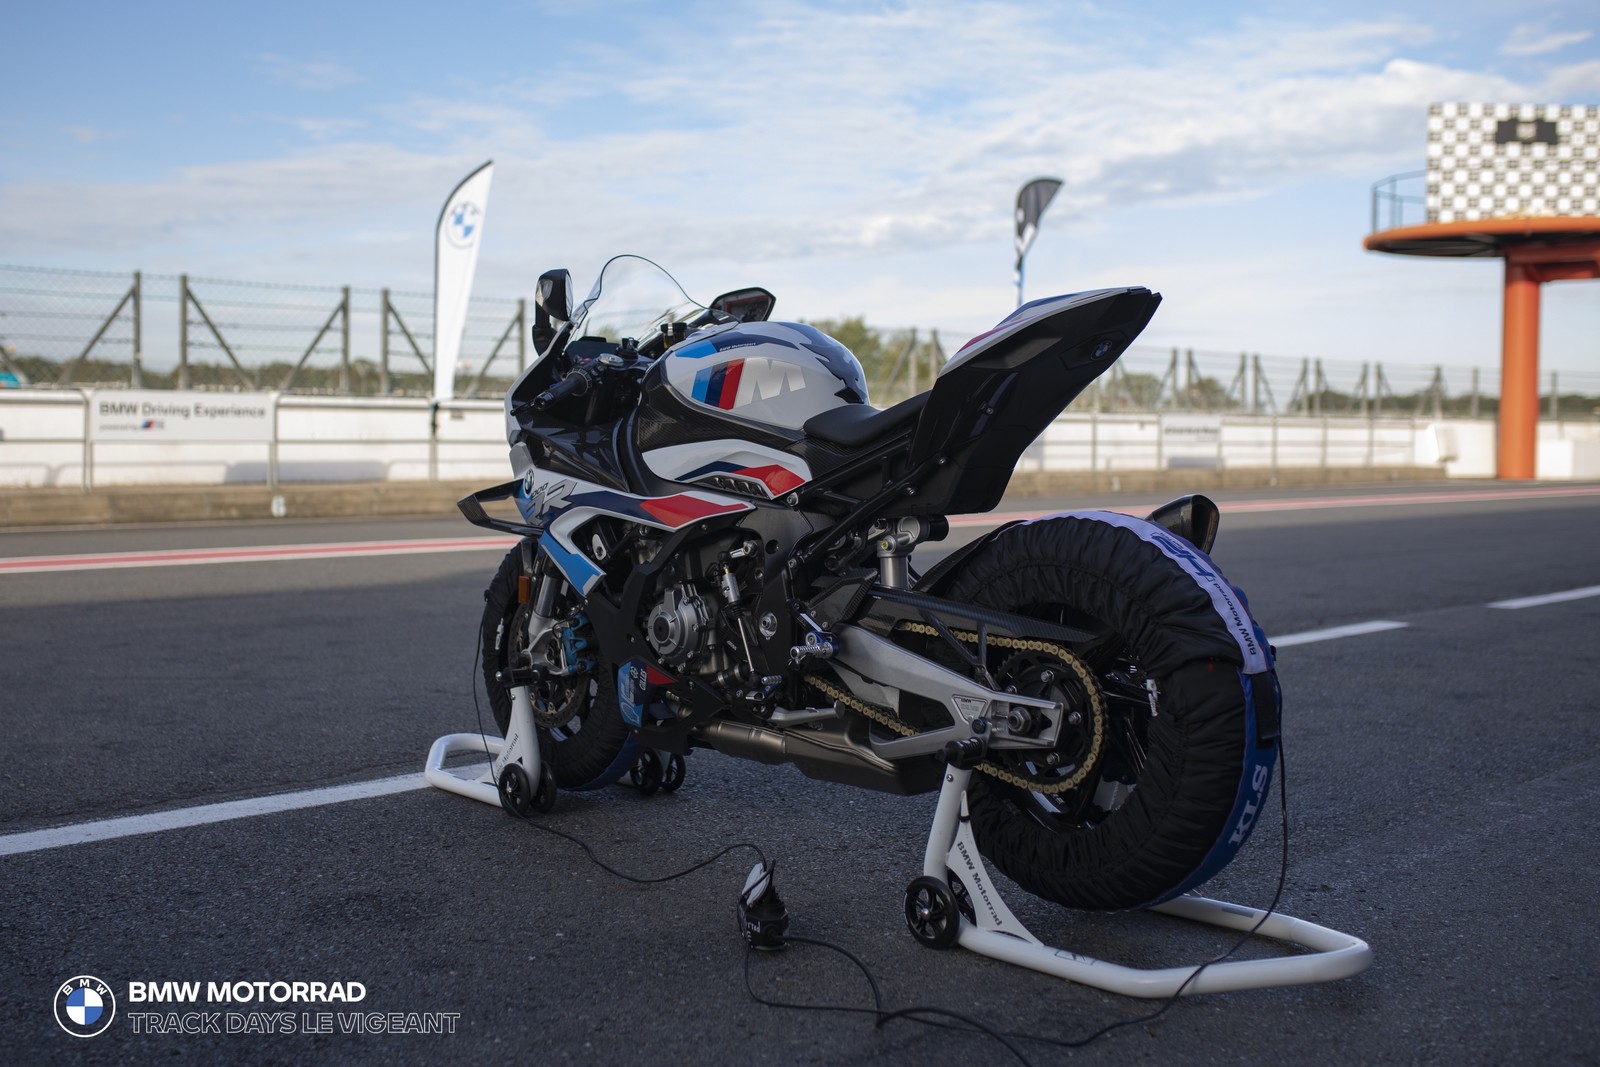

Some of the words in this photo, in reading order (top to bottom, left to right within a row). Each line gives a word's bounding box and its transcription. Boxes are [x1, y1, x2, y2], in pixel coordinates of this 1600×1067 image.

[100, 403, 138, 416] BMW
[142, 404, 191, 419] Driving
[194, 405, 266, 418] Experience
[1212, 583, 1243, 627] Motorrad
[1238, 628, 1257, 656] BMW
[1228, 764, 1268, 845] KLS
[957, 841, 975, 870] BMW
[972, 872, 1002, 926] Motorrad
